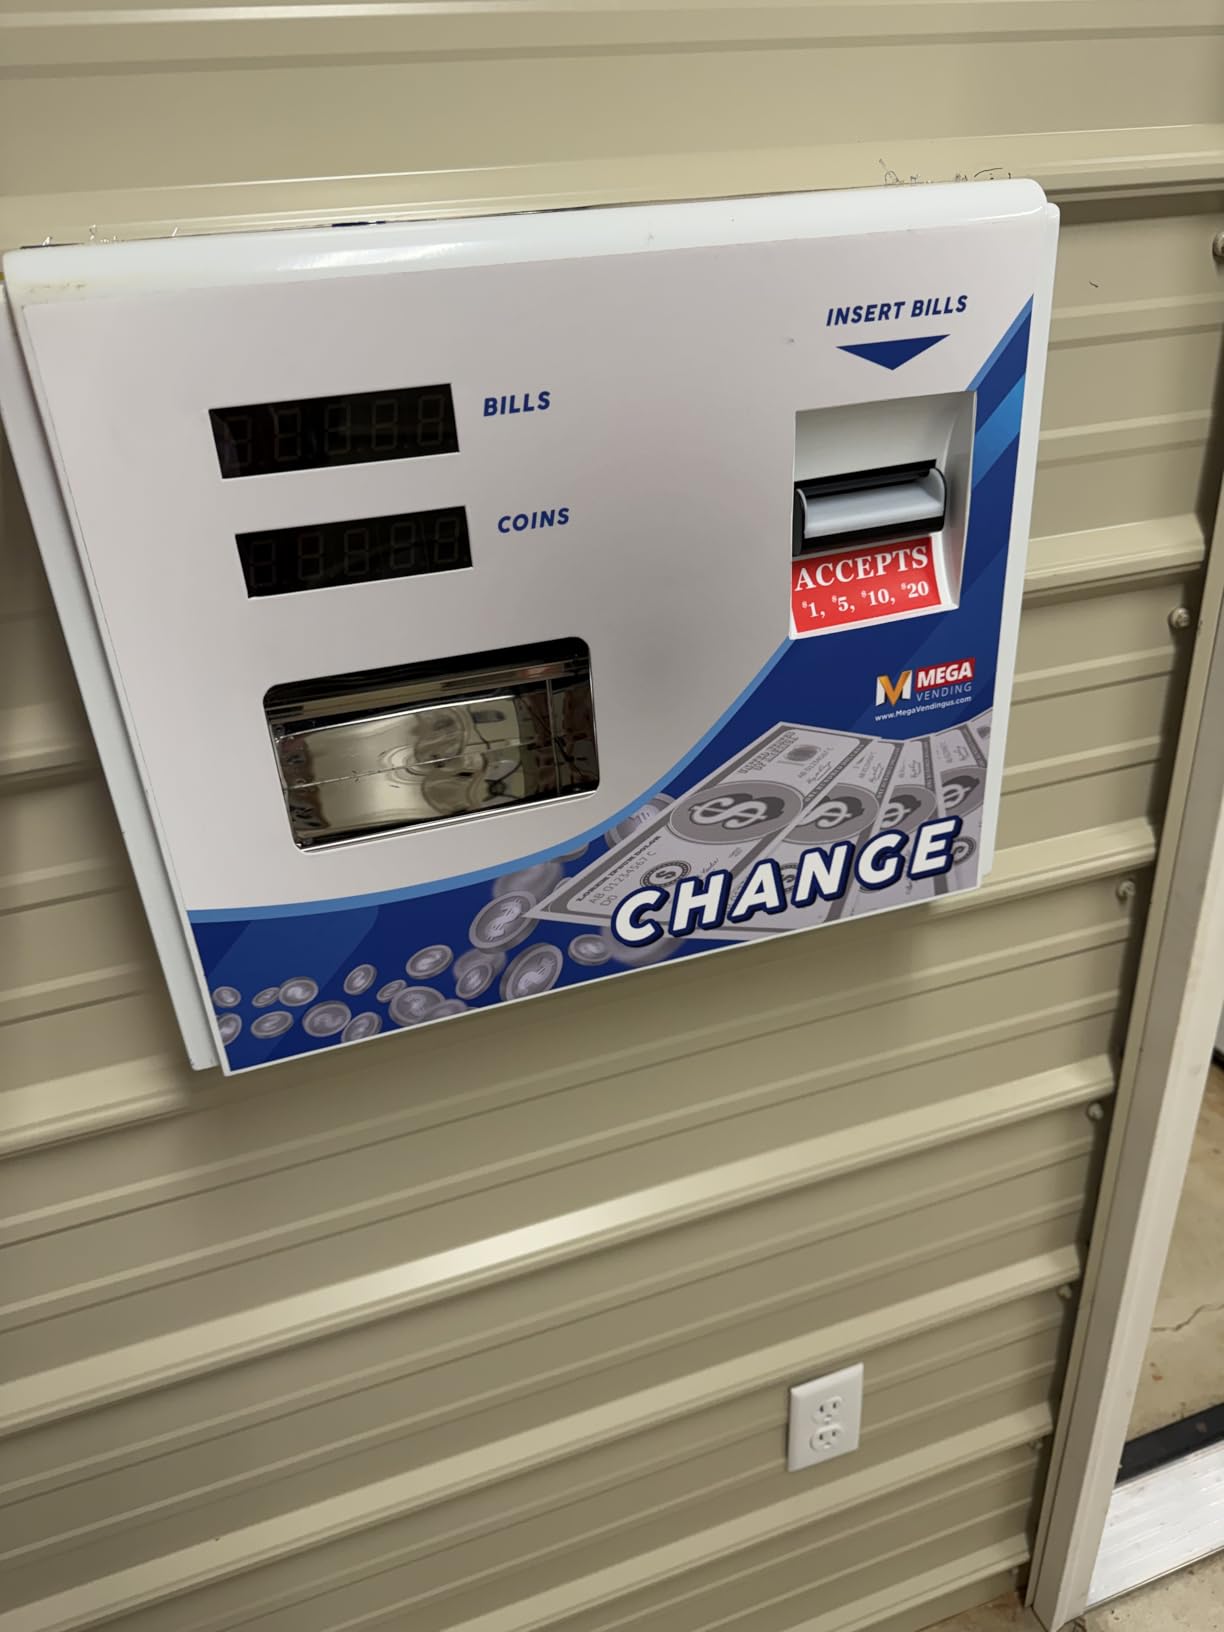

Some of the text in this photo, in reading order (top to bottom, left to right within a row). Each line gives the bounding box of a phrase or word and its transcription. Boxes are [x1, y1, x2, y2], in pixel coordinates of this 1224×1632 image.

[826, 295, 968, 327] INSERT BILLS
[483, 391, 551, 417] BILLS
[497, 507, 570, 534] COINS
[794, 545, 929, 592] ACCEPTS
[802, 580, 930, 619] $1, $5, $10, $20
[917, 661, 973, 689] MEGA
[916, 682, 973, 702] VENDING
[874, 696, 972, 721] www.MegaVendingus.com
[612, 816, 961, 946] CHANGE
